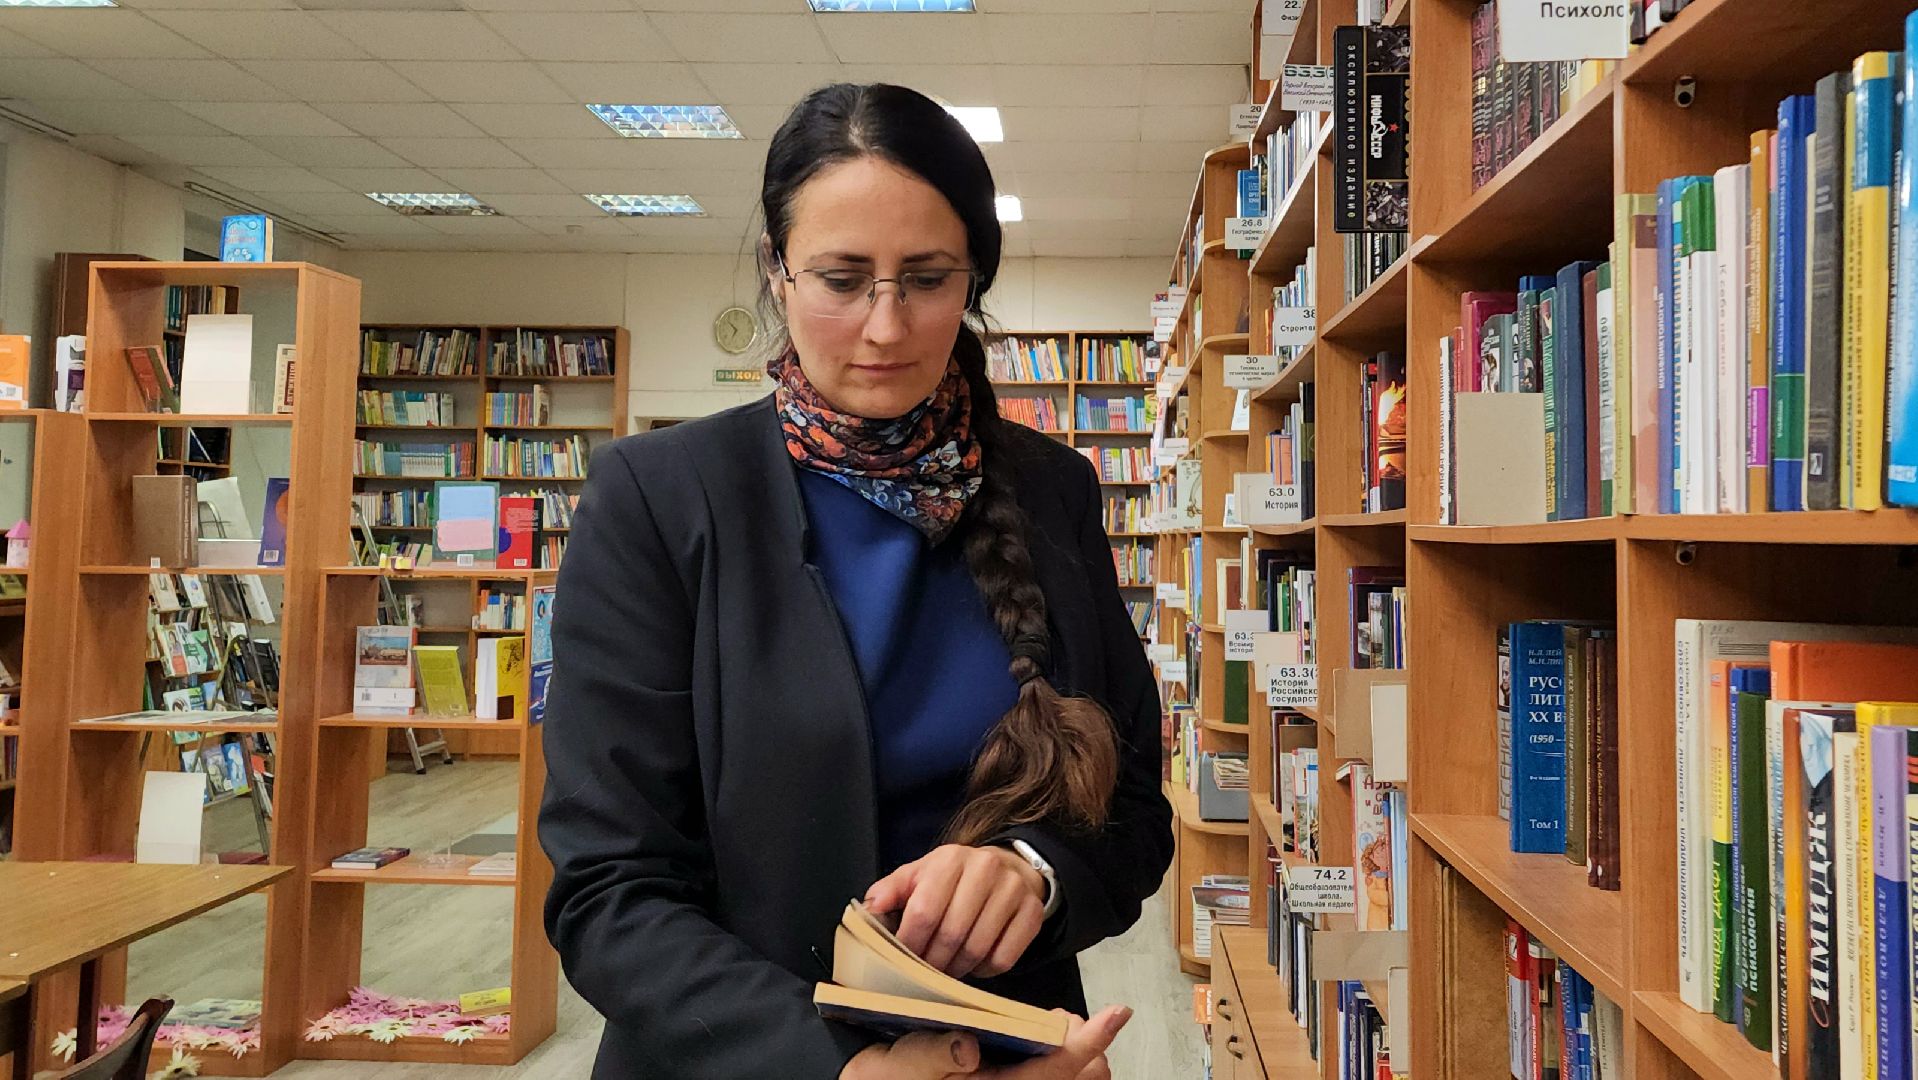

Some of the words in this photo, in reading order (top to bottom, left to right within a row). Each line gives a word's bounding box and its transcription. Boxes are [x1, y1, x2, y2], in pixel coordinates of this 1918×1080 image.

[1347, 45, 1356, 150] ЭКСКЛЮЗИВНОЕ
[1346, 159, 1356, 218] ИЗДАНИЕ
[1241, 219, 1262, 227] 26.8
[1269, 487, 1295, 497] 63.0
[1265, 500, 1299, 510] История
[1271, 679, 1309, 688] История
[1529, 676, 1562, 691] РУС
[1553, 711, 1566, 723] В
[1529, 734, 1555, 744] (1950
[1529, 818, 1551, 829] Том
[1553, 818, 1559, 829] 1
[1314, 869, 1347, 881] 74.2
[1808, 811, 1832, 1005] ИМИДЖ
[1878, 887, 1888, 980] ДЕЛОВОЕ
